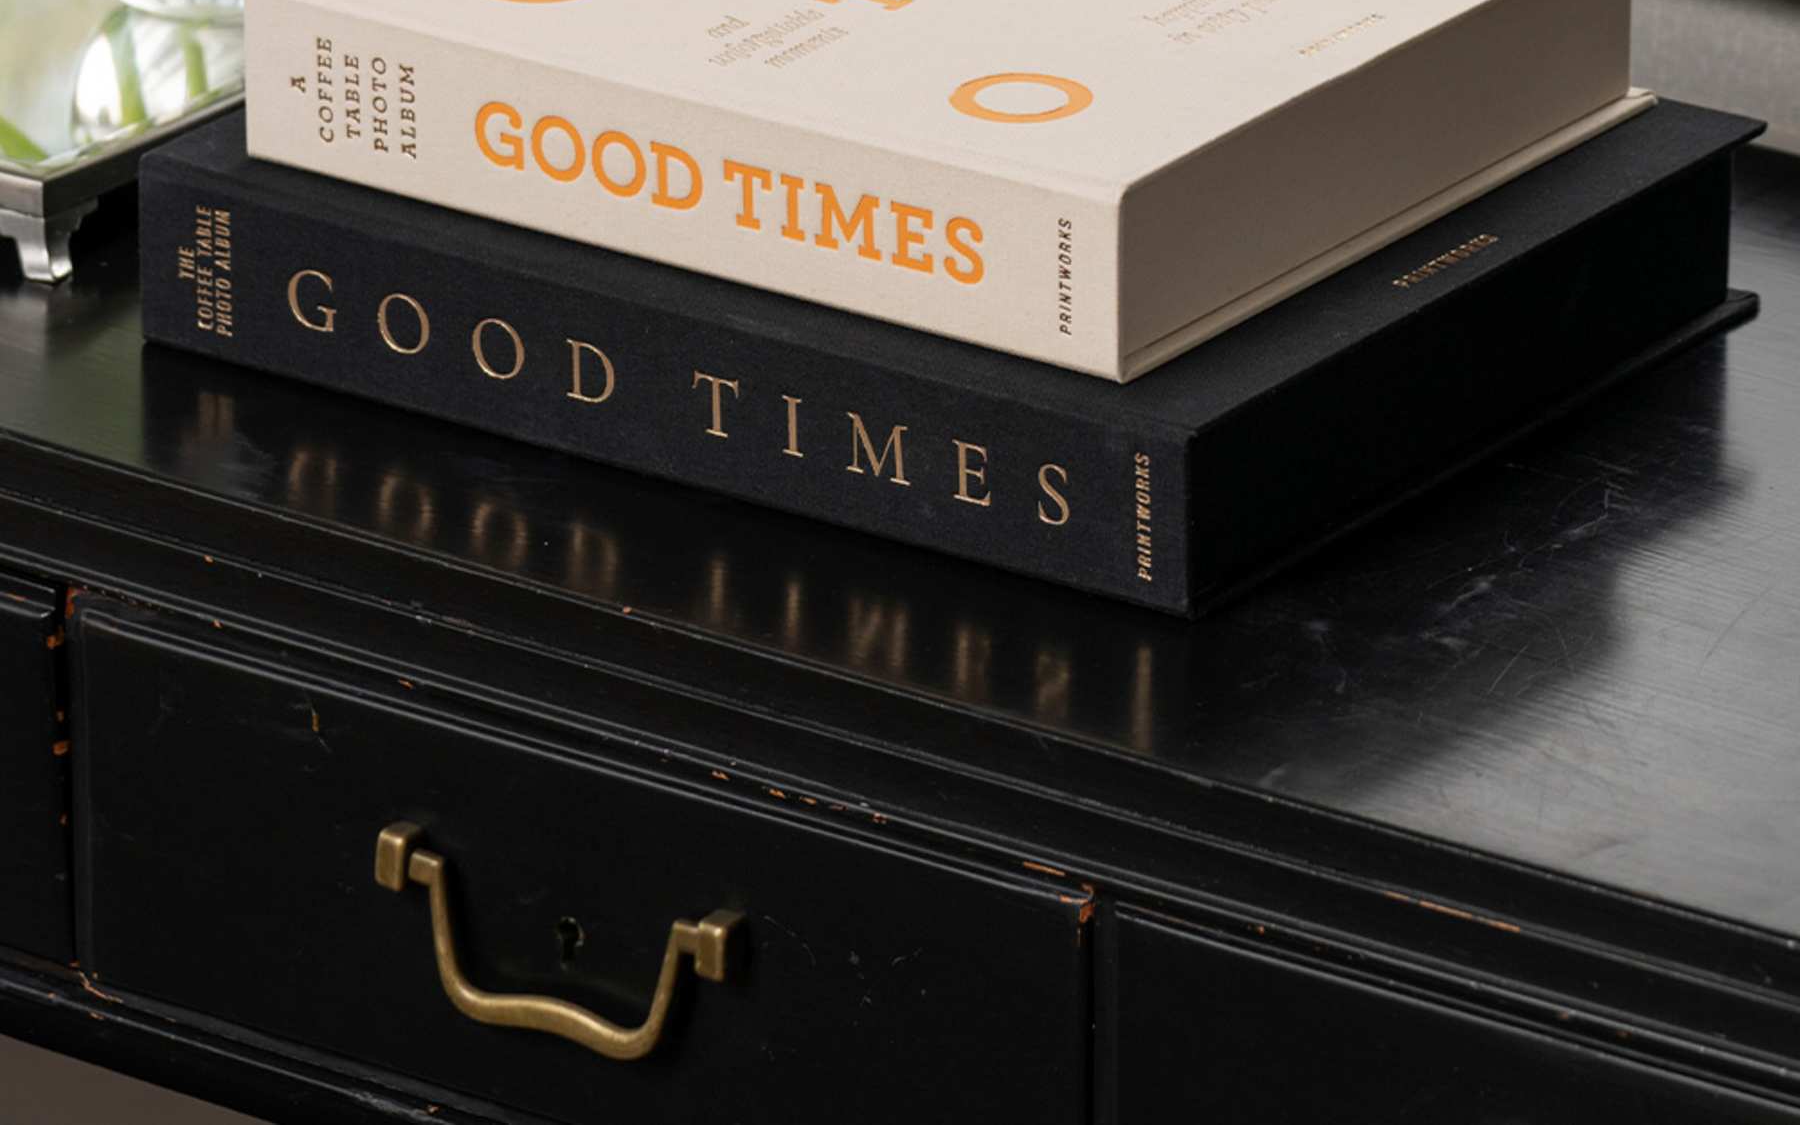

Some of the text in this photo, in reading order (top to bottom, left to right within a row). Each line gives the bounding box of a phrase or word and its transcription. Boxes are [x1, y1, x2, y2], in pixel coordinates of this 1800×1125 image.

[290, 76, 306, 93] A
[316, 37, 334, 143] COFFEE
[344, 54, 361, 139] TABLE
[371, 56, 389, 153] PHOTO
[399, 63, 417, 159] ALBUM
[949, 73, 1093, 123] O
[474, 101, 985, 285] GOOD TIMES
[177, 245, 195, 280] THE
[195, 204, 213, 331] COFFEE TABLE
[214, 208, 233, 337] PHOTO ALBUM
[1057, 217, 1073, 336] PRINTWORKS
[286, 269, 616, 403] GOOD
[692, 370, 1072, 526] TIMES
[1136, 452, 1153, 582] PRINTWORKS
